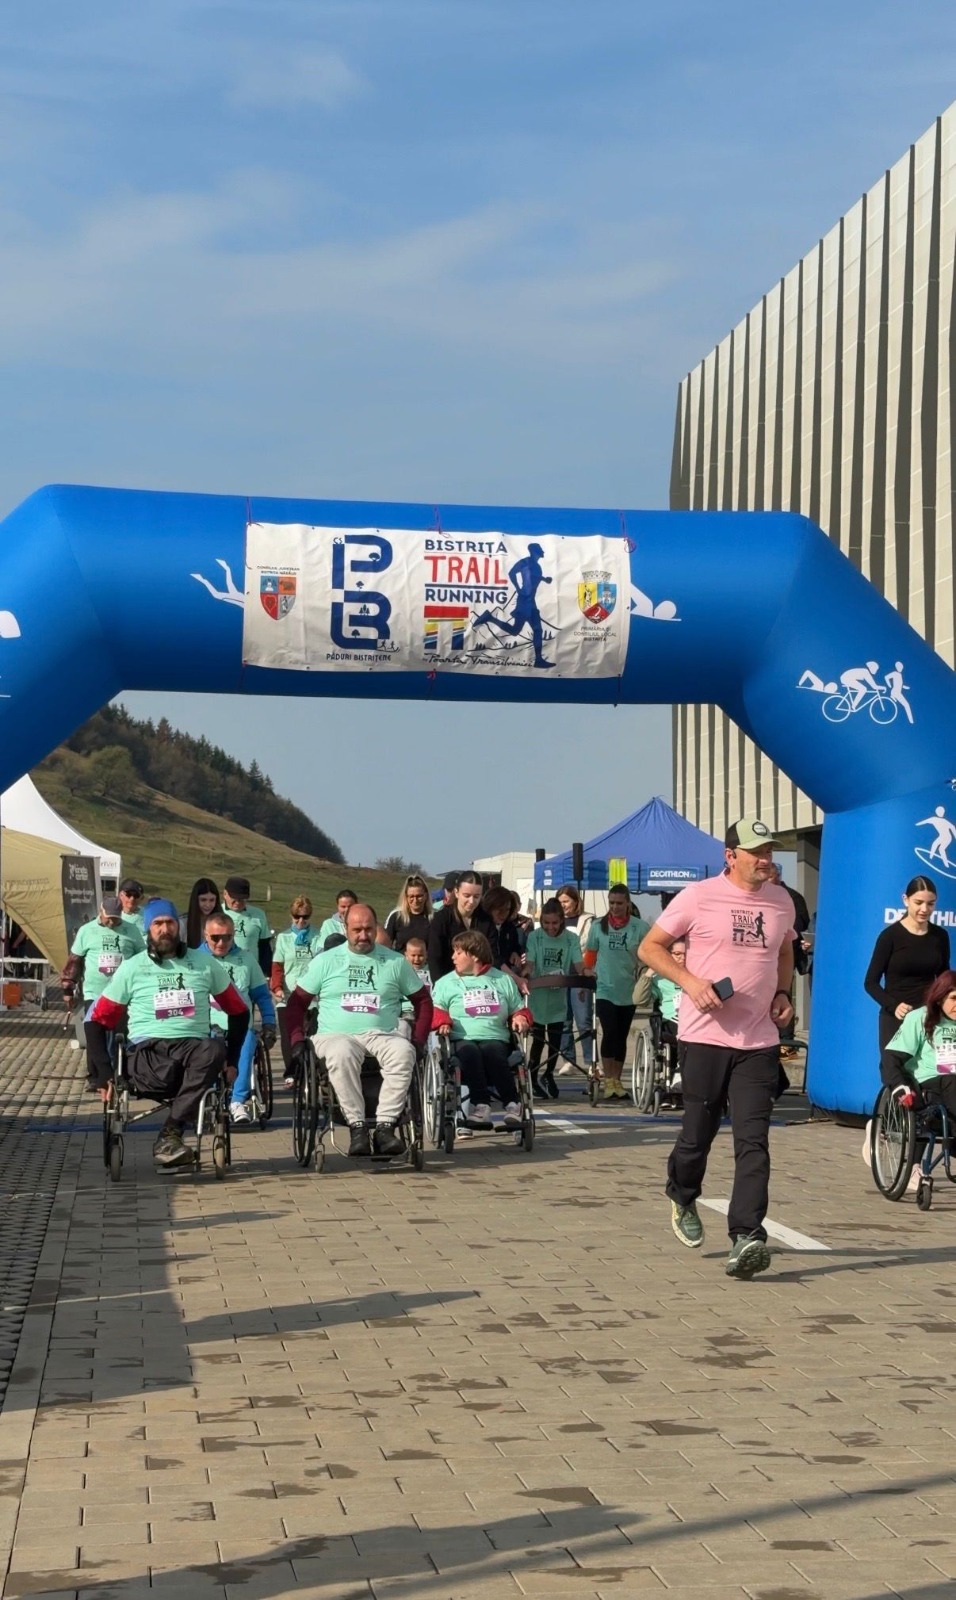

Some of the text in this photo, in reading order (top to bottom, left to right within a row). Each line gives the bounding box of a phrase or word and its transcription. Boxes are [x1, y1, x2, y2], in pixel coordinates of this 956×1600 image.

[424, 539, 508, 557] BISTRIȚA
[424, 555, 508, 585] TRAIL
[425, 588, 508, 604] RUNNING
[475, 1006, 491, 1014] 320
